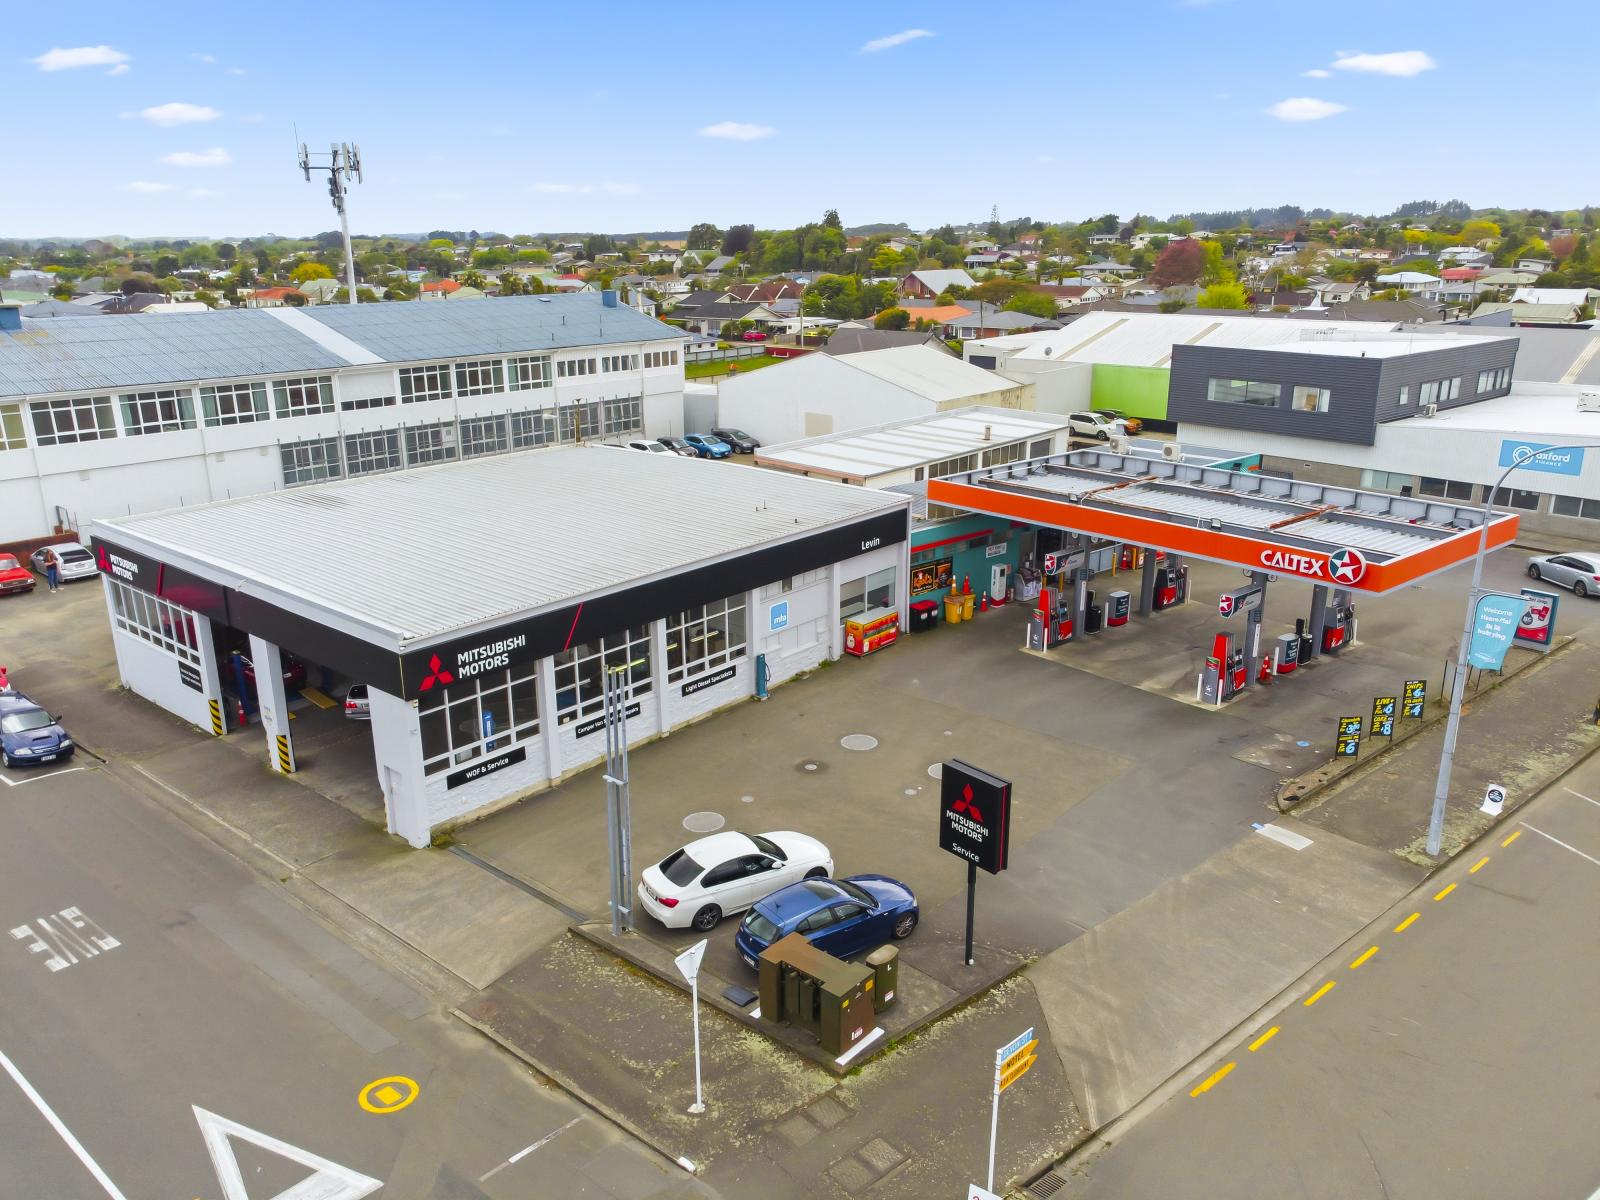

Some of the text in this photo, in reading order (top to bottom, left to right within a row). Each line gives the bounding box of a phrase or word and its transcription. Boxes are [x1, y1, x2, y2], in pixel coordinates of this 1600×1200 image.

[1535, 452, 1570, 463] oxford
[861, 537, 880, 550] Levin
[109, 554, 138, 574] MITSUBISHI
[112, 565, 133, 580] MOTORS
[1260, 550, 1324, 577] CALTEX
[457, 634, 526, 666] MITSUBISHI
[458, 653, 509, 679] MOTORS
[685, 683, 698, 693] Light
[698, 678, 711, 688] Diesel
[465, 757, 509, 779] WOF & Service
[946, 809, 989, 837] MITSUBISHI
[951, 821, 982, 843] MOTORS
[952, 842, 980, 863] Service
